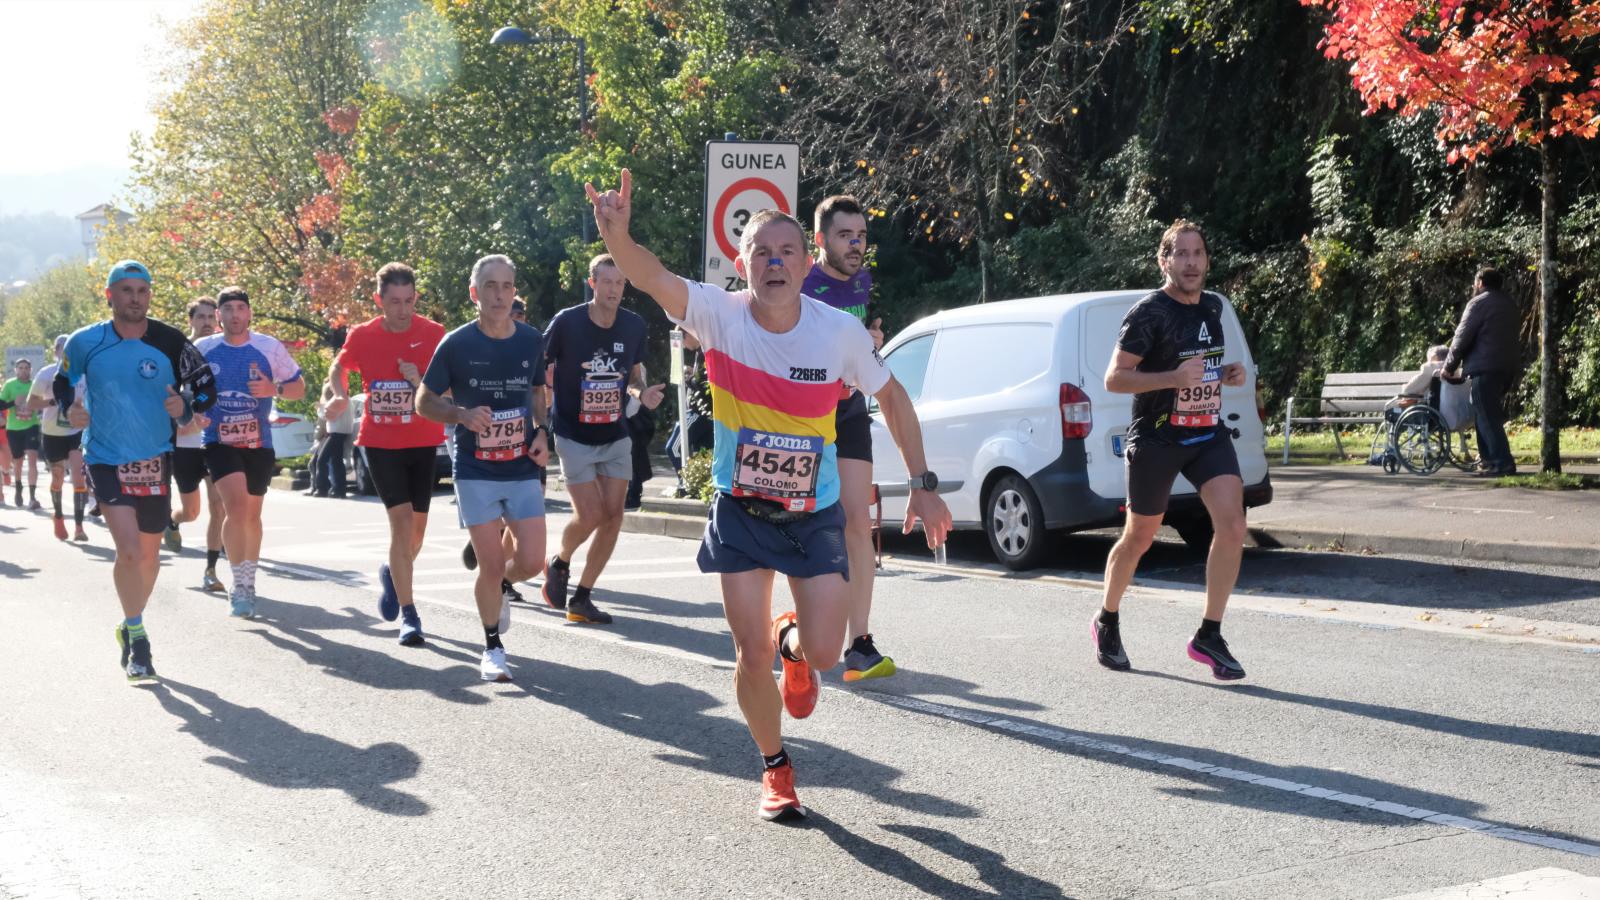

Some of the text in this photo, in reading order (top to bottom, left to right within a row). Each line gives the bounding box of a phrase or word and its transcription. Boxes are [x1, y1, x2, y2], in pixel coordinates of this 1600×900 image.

[721, 153, 787, 170] GUNEA
[789, 366, 827, 382] 226ERS
[373, 391, 412, 404] 3457
[585, 390, 619, 404] 3923
[1179, 383, 1220, 402] 3994
[220, 421, 257, 436] 5478
[480, 419, 524, 439] 3784
[742, 449, 813, 478] 4543
[754, 476, 798, 490] COLOMO
